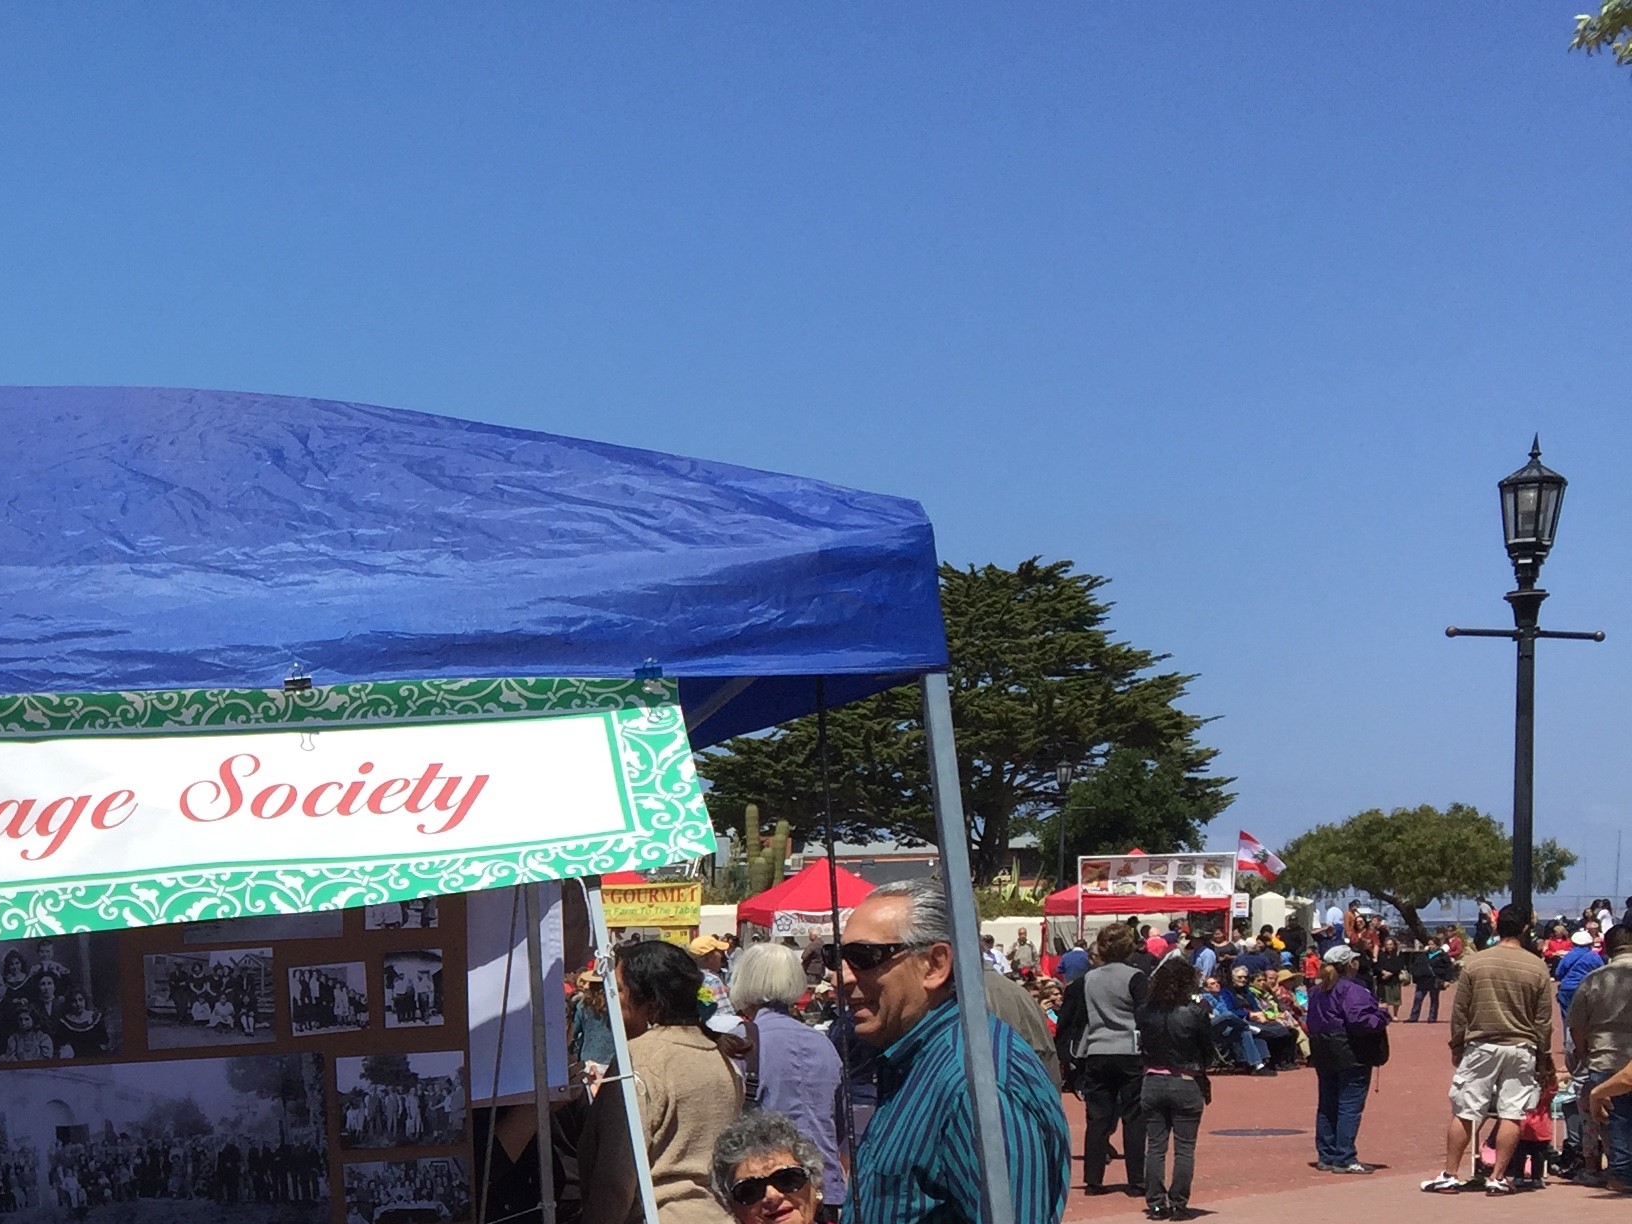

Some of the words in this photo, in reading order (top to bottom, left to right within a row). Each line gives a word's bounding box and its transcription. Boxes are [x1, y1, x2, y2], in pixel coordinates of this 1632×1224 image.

[179, 752, 491, 834] Society
[610, 886, 699, 904] GOURMET
[655, 905, 671, 915] The
[675, 905, 699, 914] Table
